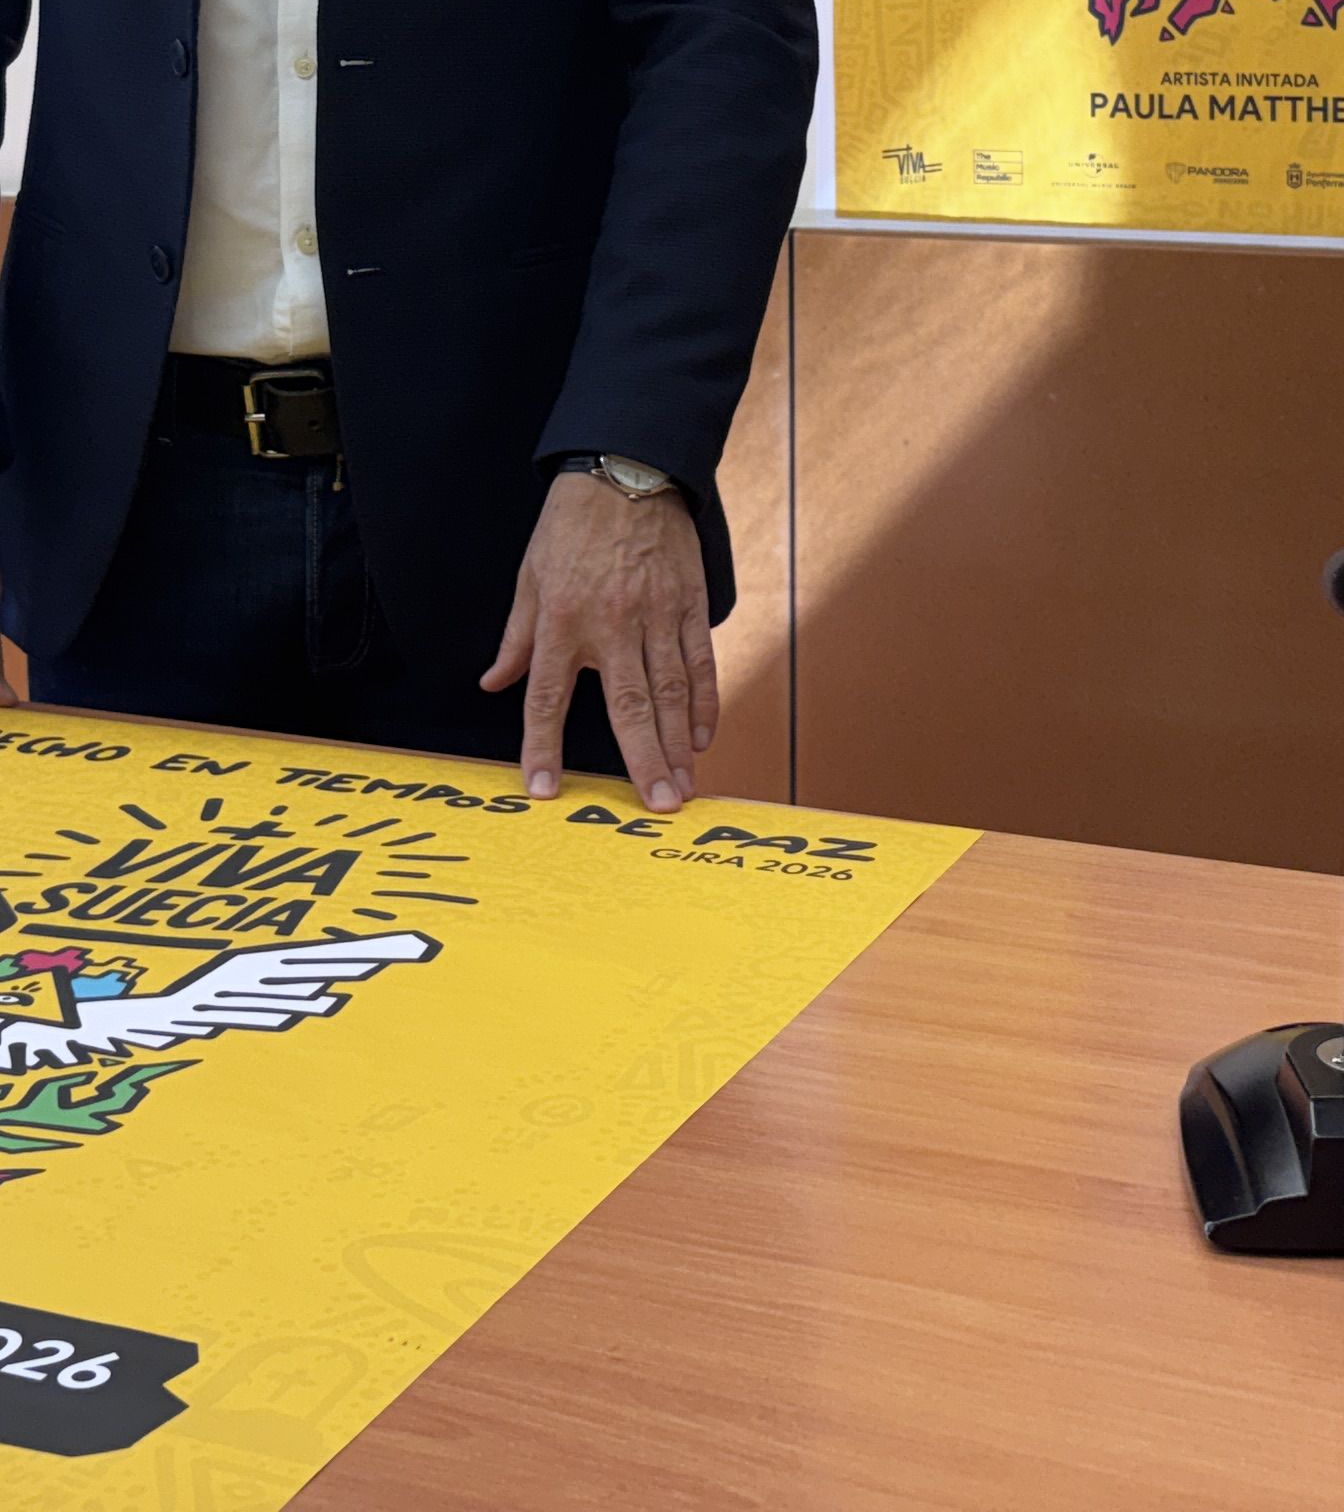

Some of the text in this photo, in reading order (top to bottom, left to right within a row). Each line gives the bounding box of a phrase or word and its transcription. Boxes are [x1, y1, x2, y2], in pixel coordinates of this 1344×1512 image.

[1160, 71, 1320, 89] ARTISTA INVITADA
[1090, 92, 1200, 122] PAULA
[1187, 165, 1249, 178] PANDORA
[150, 752, 253, 777] EN
[565, 803, 673, 839] DE
[693, 825, 877, 863] PAZ
[84, 839, 363, 897] VIVA
[649, 847, 855, 882] GIRA 2026
[17, 883, 307, 937] SUECIA
